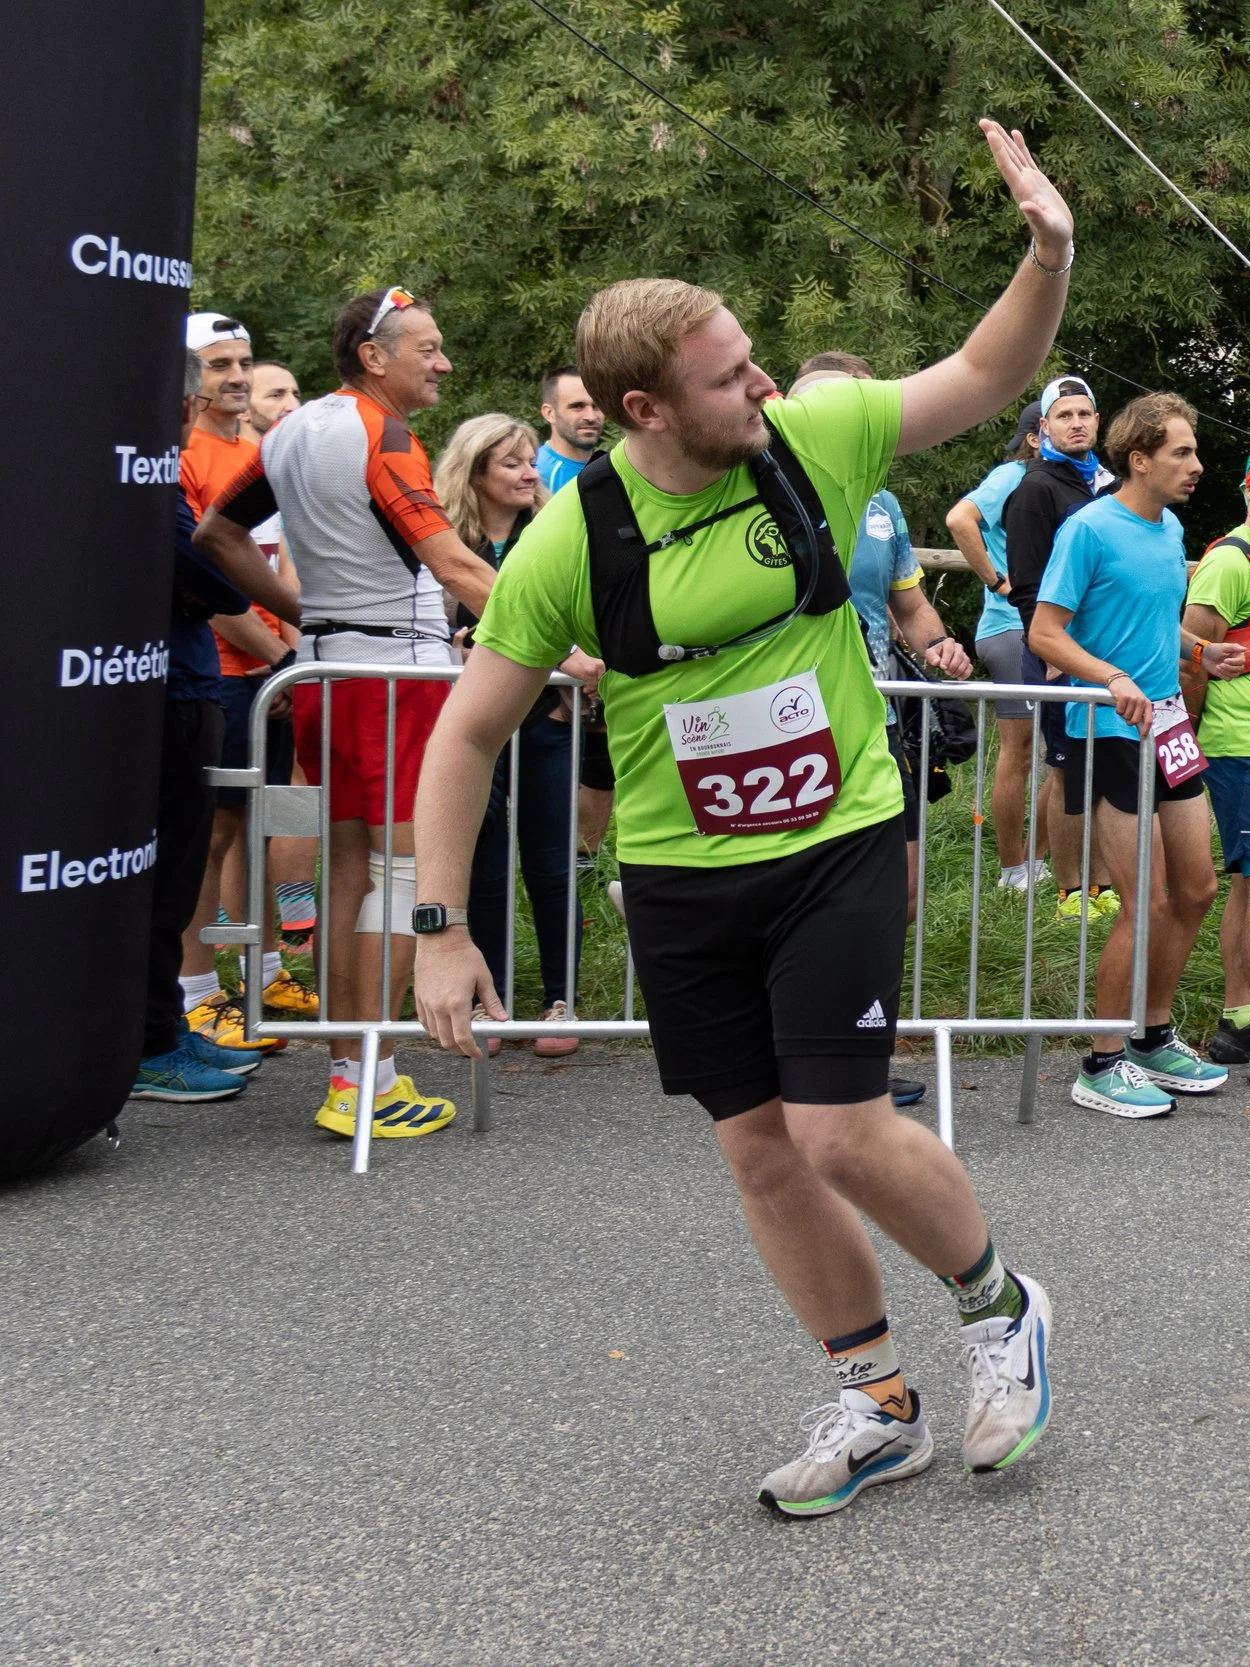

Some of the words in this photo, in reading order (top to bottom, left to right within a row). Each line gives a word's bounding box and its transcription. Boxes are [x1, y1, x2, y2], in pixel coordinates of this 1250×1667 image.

[1159, 732, 1200, 775] 258
[697, 753, 834, 817] 322
[856, 1018, 887, 1028] adidas
